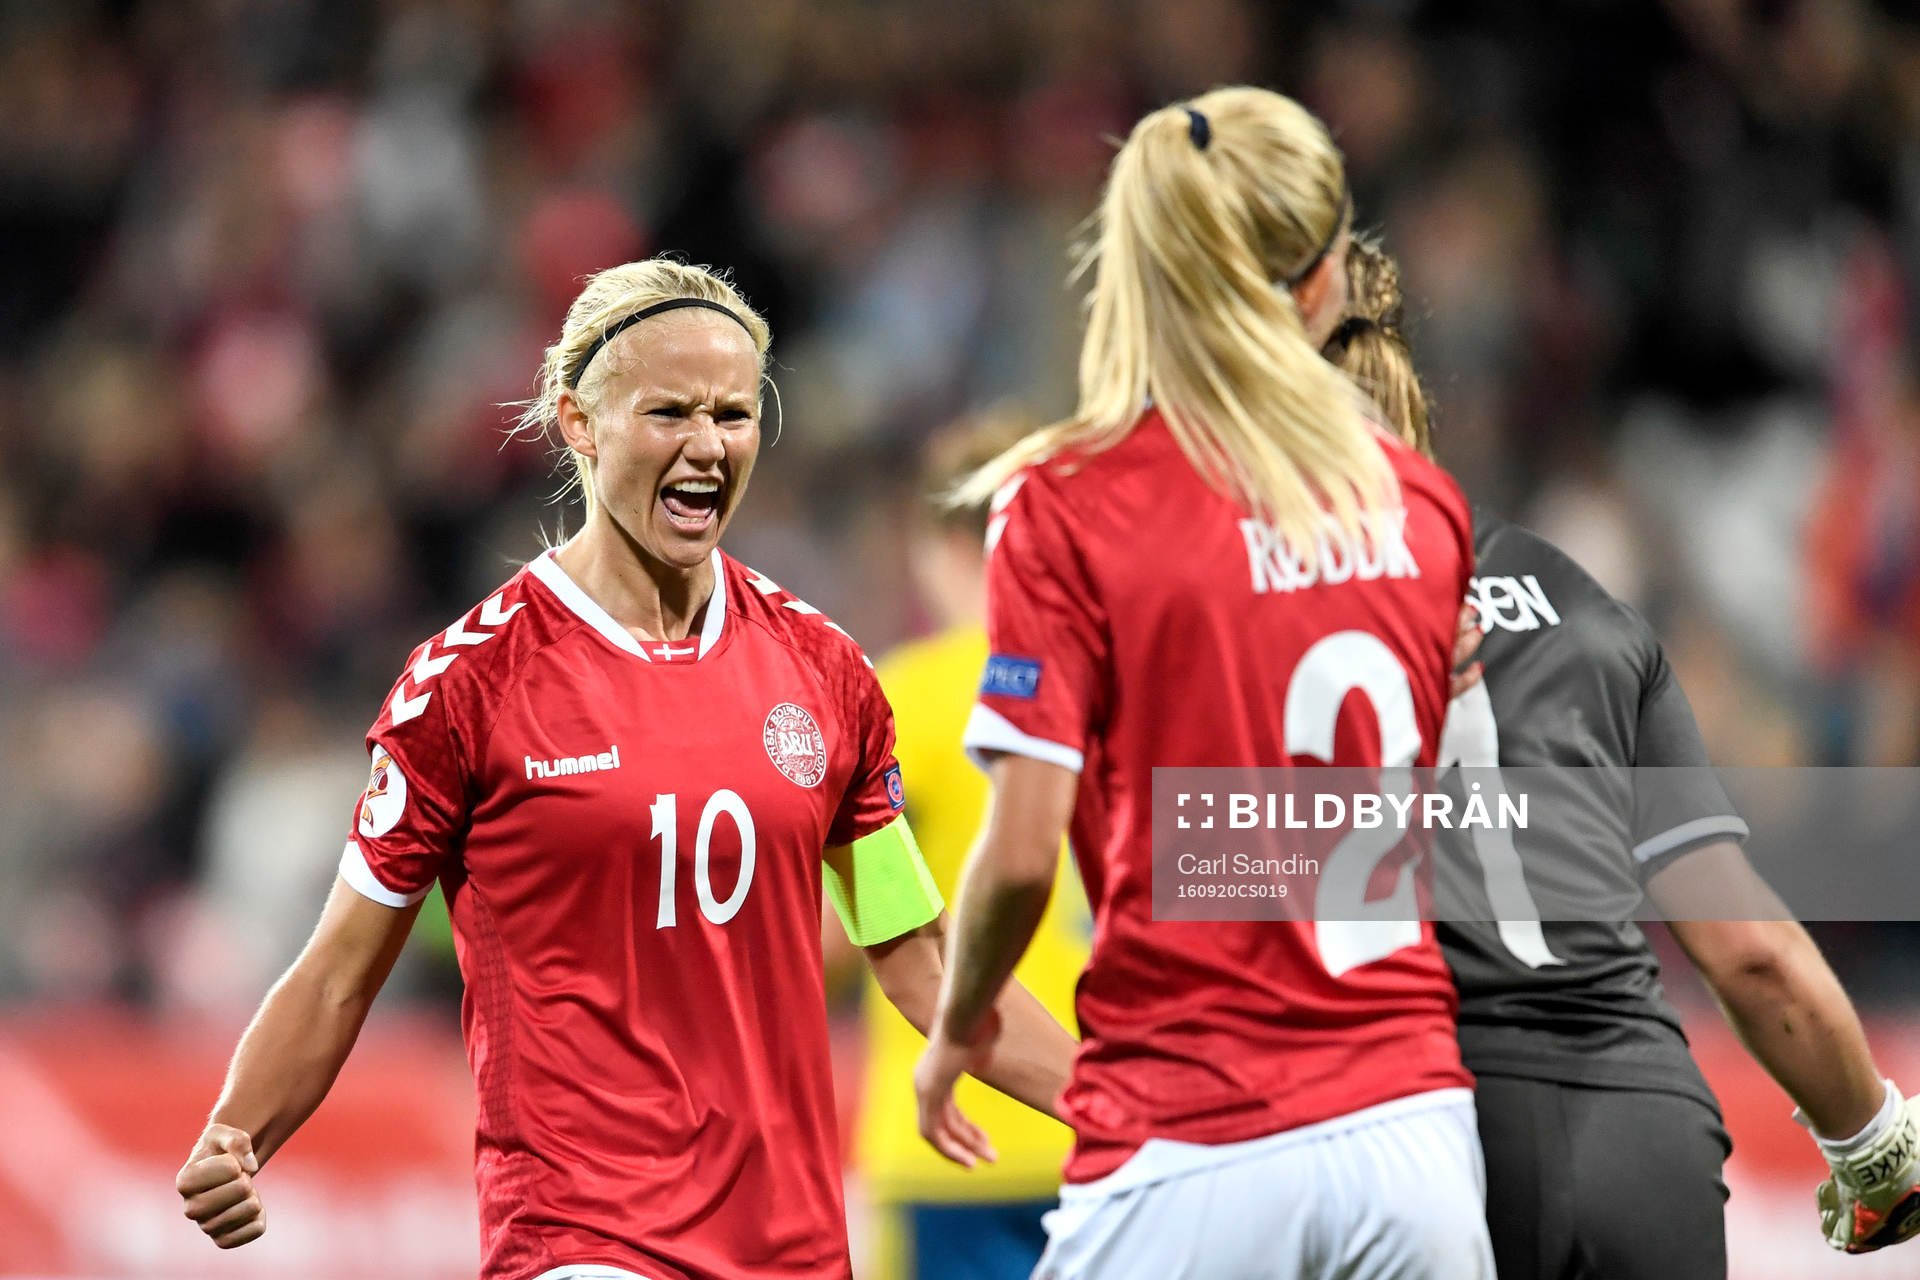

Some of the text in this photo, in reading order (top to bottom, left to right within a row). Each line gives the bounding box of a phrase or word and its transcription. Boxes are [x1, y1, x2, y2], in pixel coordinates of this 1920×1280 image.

[524, 744, 621, 780] hummel
[778, 731, 815, 757] DBU
[1284, 630, 1423, 978] 2
[649, 788, 757, 930] 10
